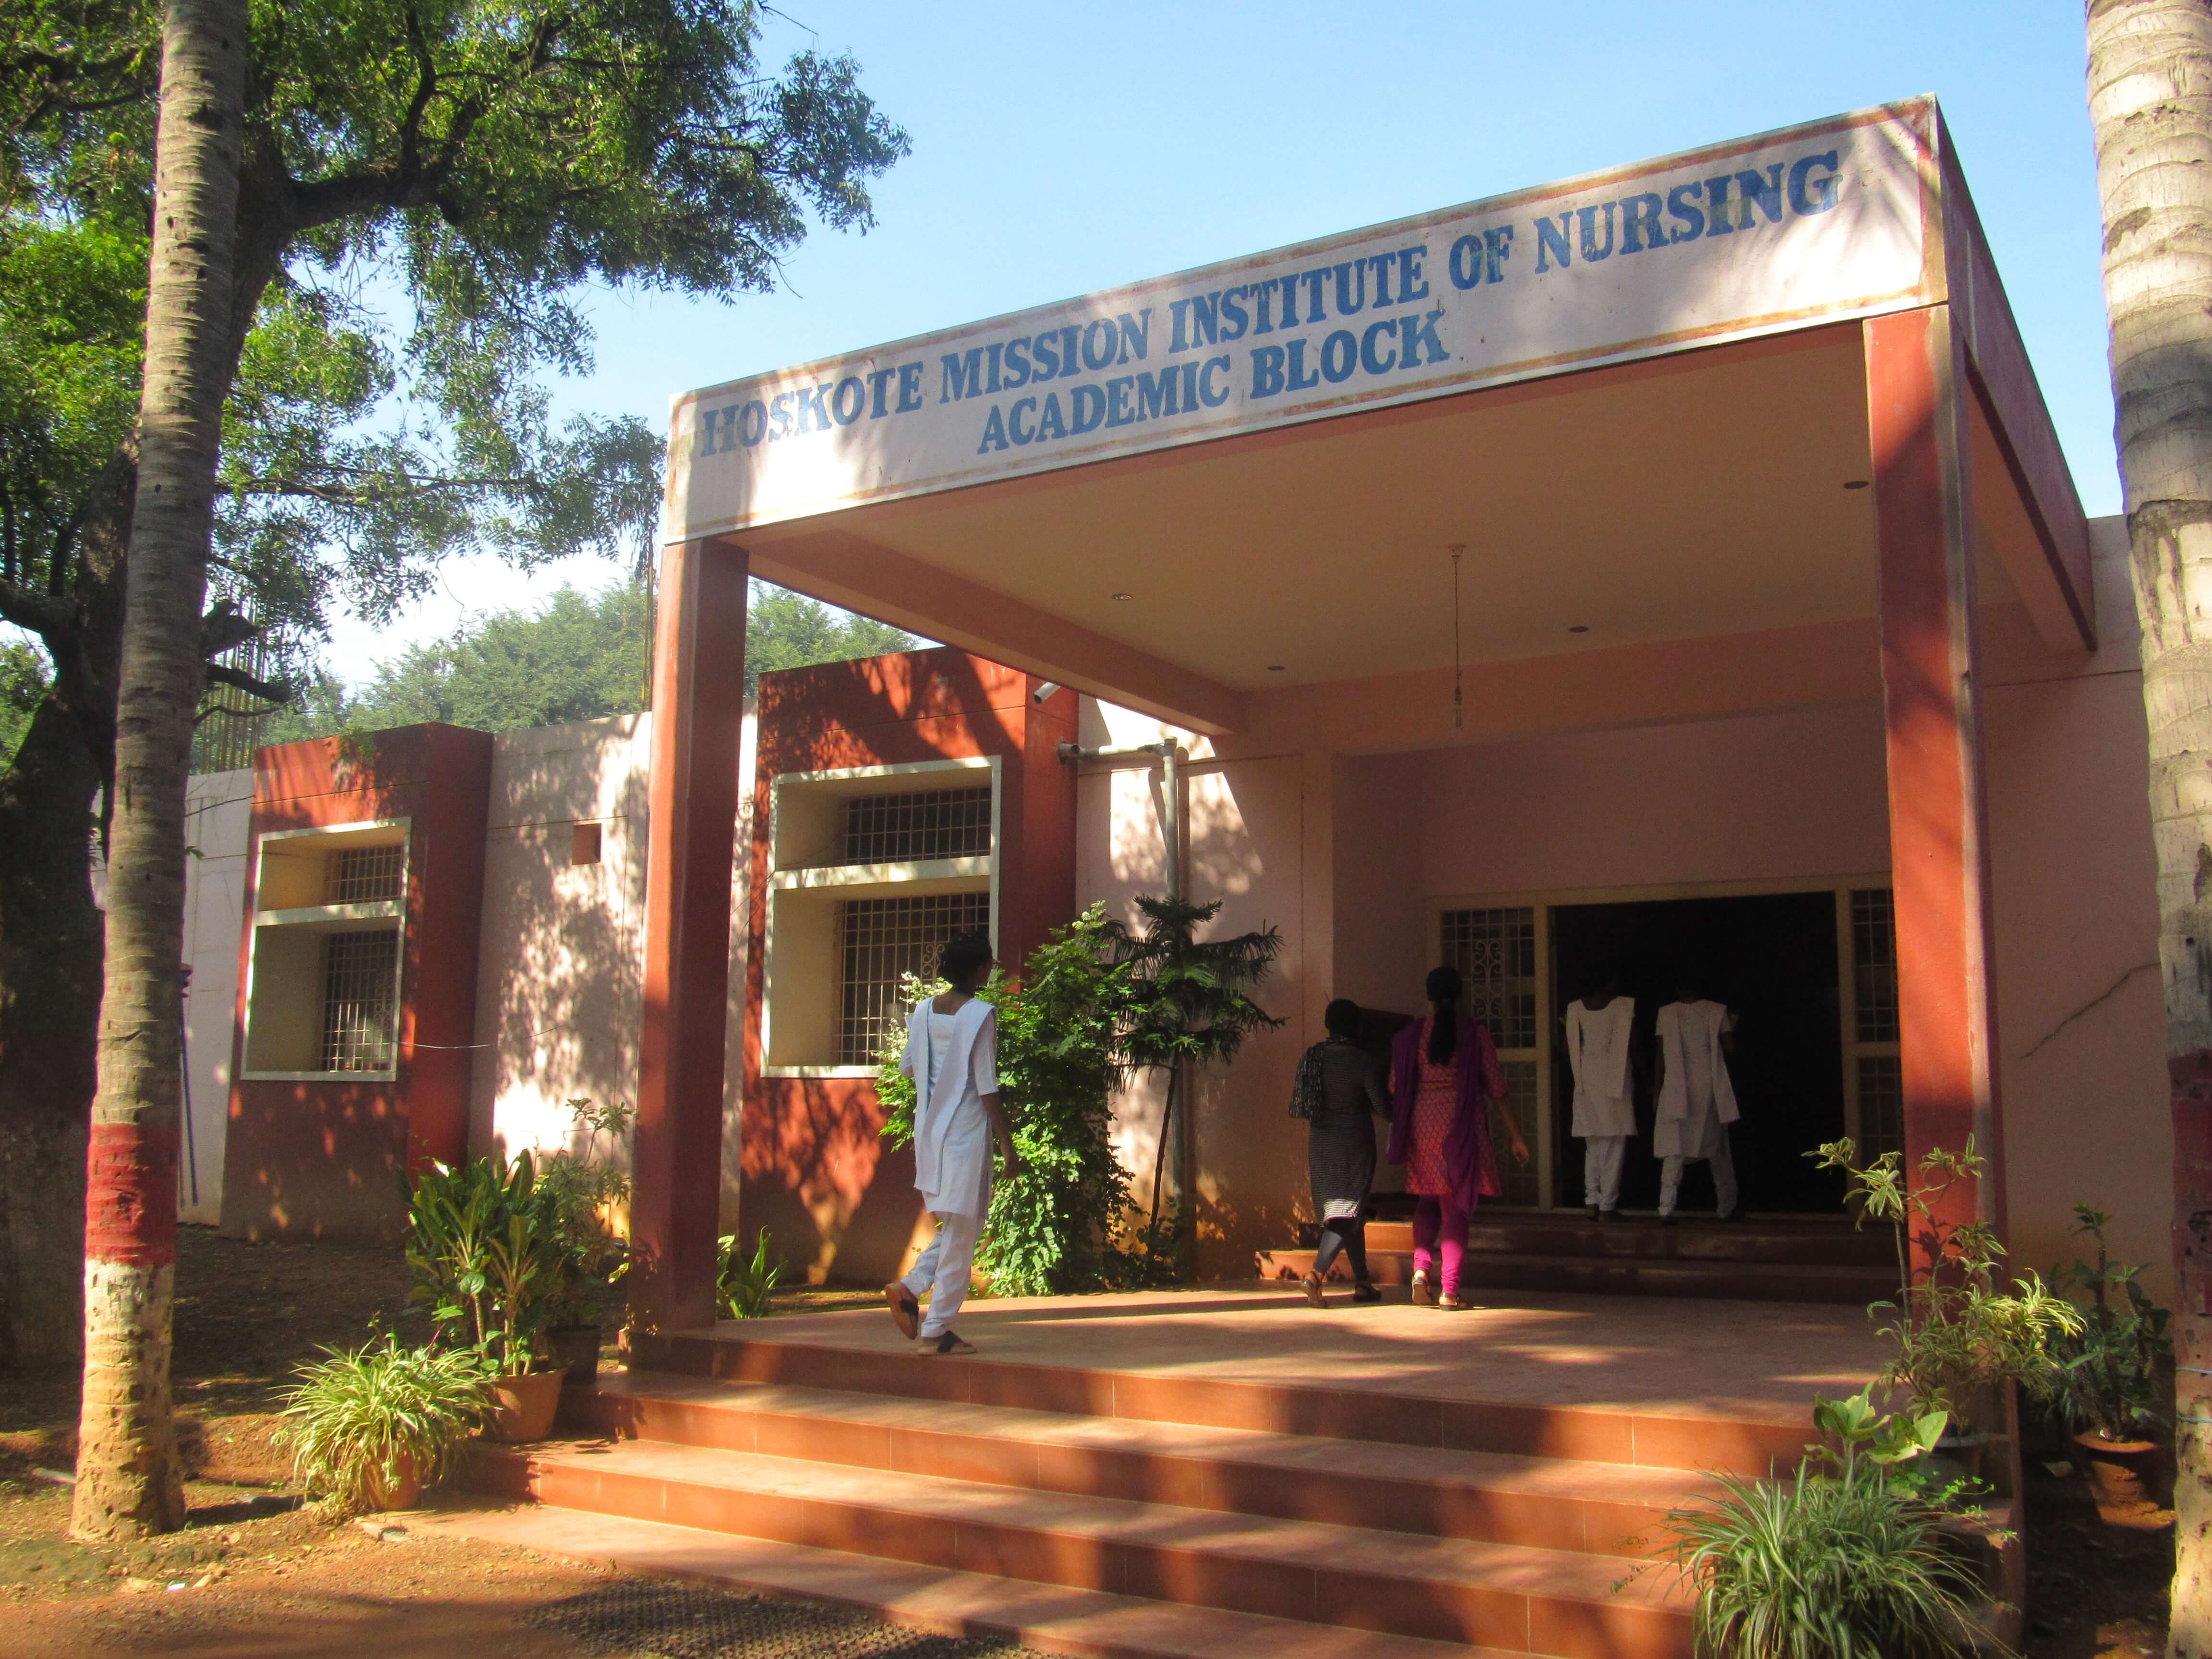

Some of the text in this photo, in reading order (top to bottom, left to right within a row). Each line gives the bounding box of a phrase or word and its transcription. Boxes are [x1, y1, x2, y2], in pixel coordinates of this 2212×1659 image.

[701, 149, 1842, 457] HOSKOTE MISSION INSTITUTE OF NURSING
[977, 310, 1449, 454] ACADEMIC BLOCK
